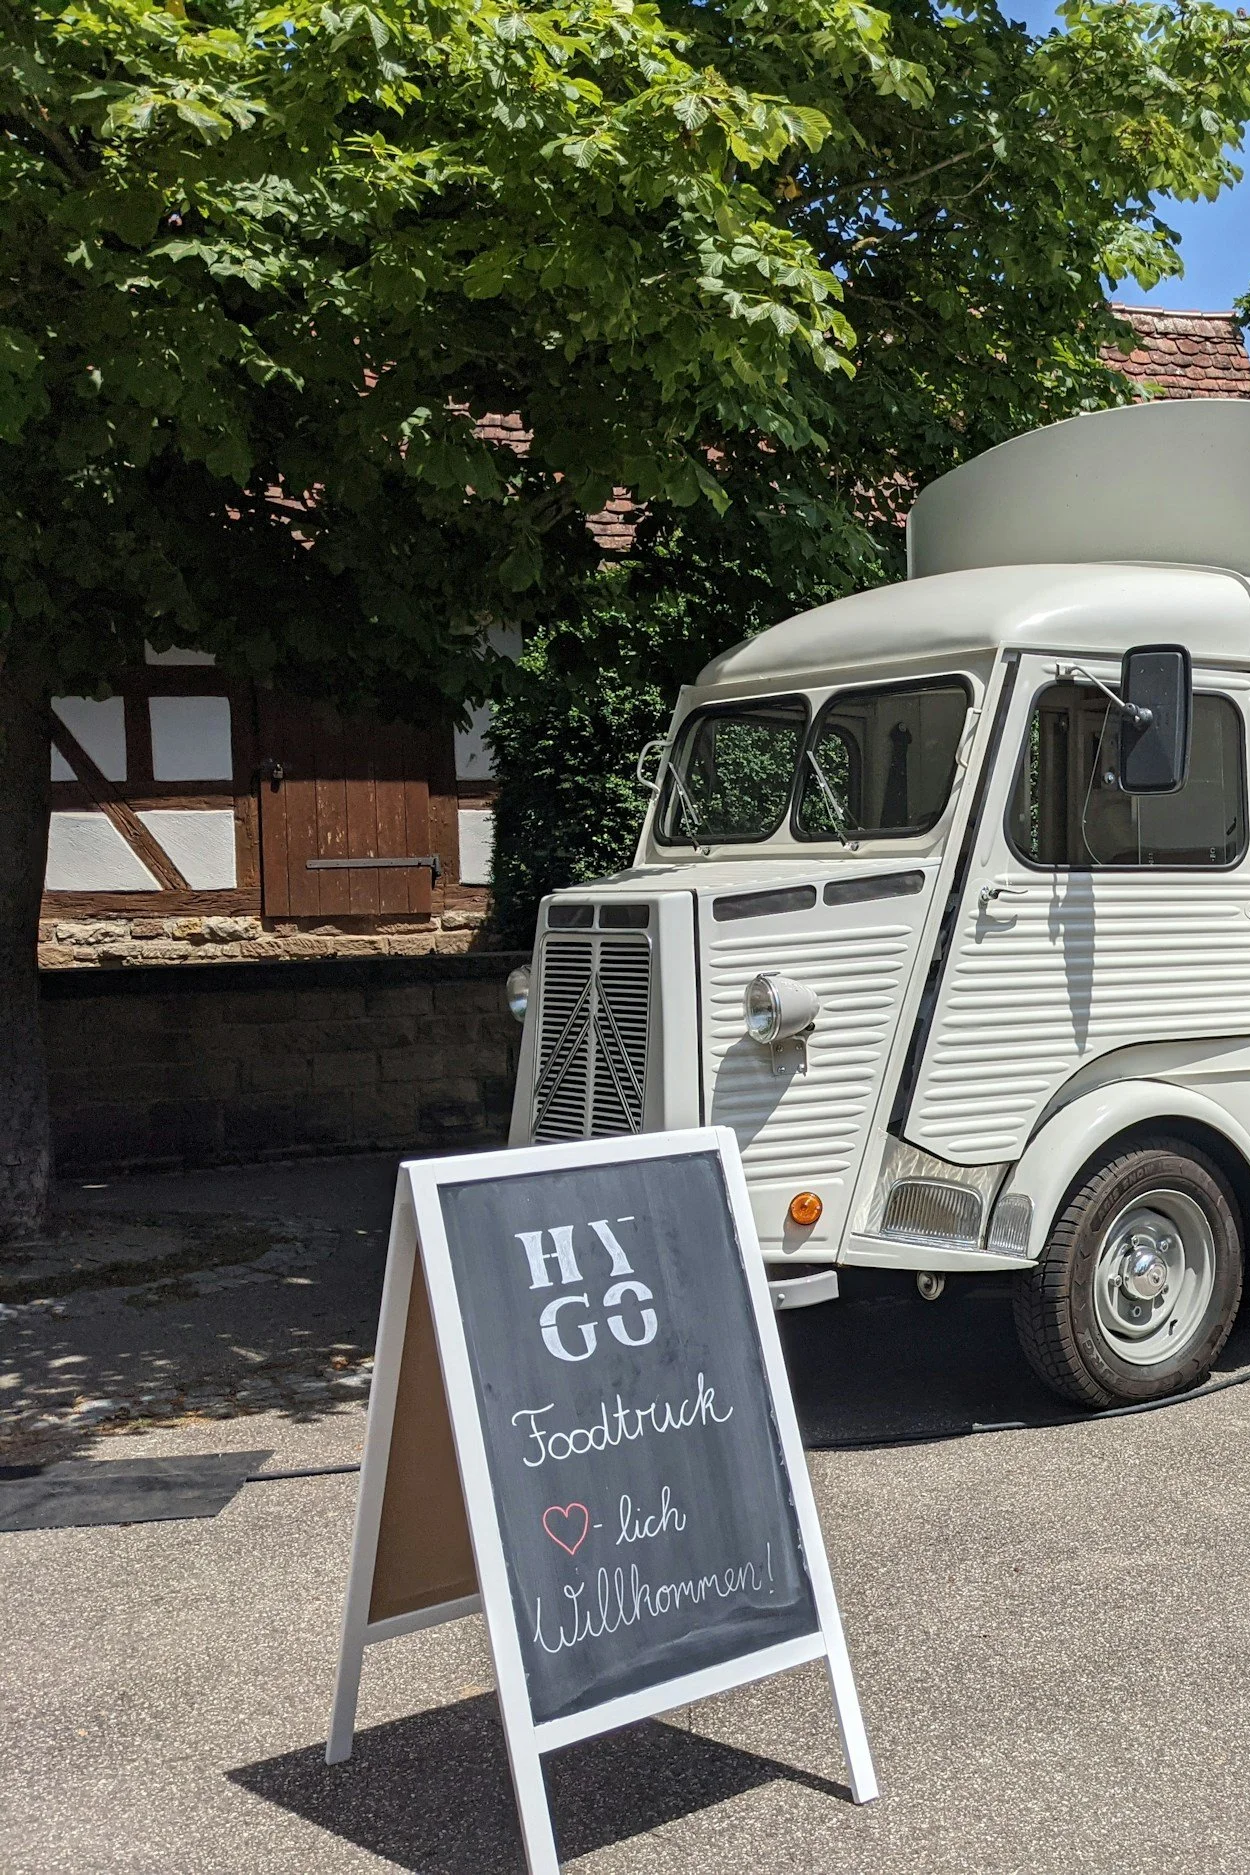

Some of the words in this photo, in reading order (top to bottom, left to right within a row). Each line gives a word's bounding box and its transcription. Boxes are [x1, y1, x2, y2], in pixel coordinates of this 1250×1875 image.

[515, 1215, 635, 1290] HY
[540, 1281, 658, 1362] GO
[511, 1372, 734, 1468] Foodtruck
